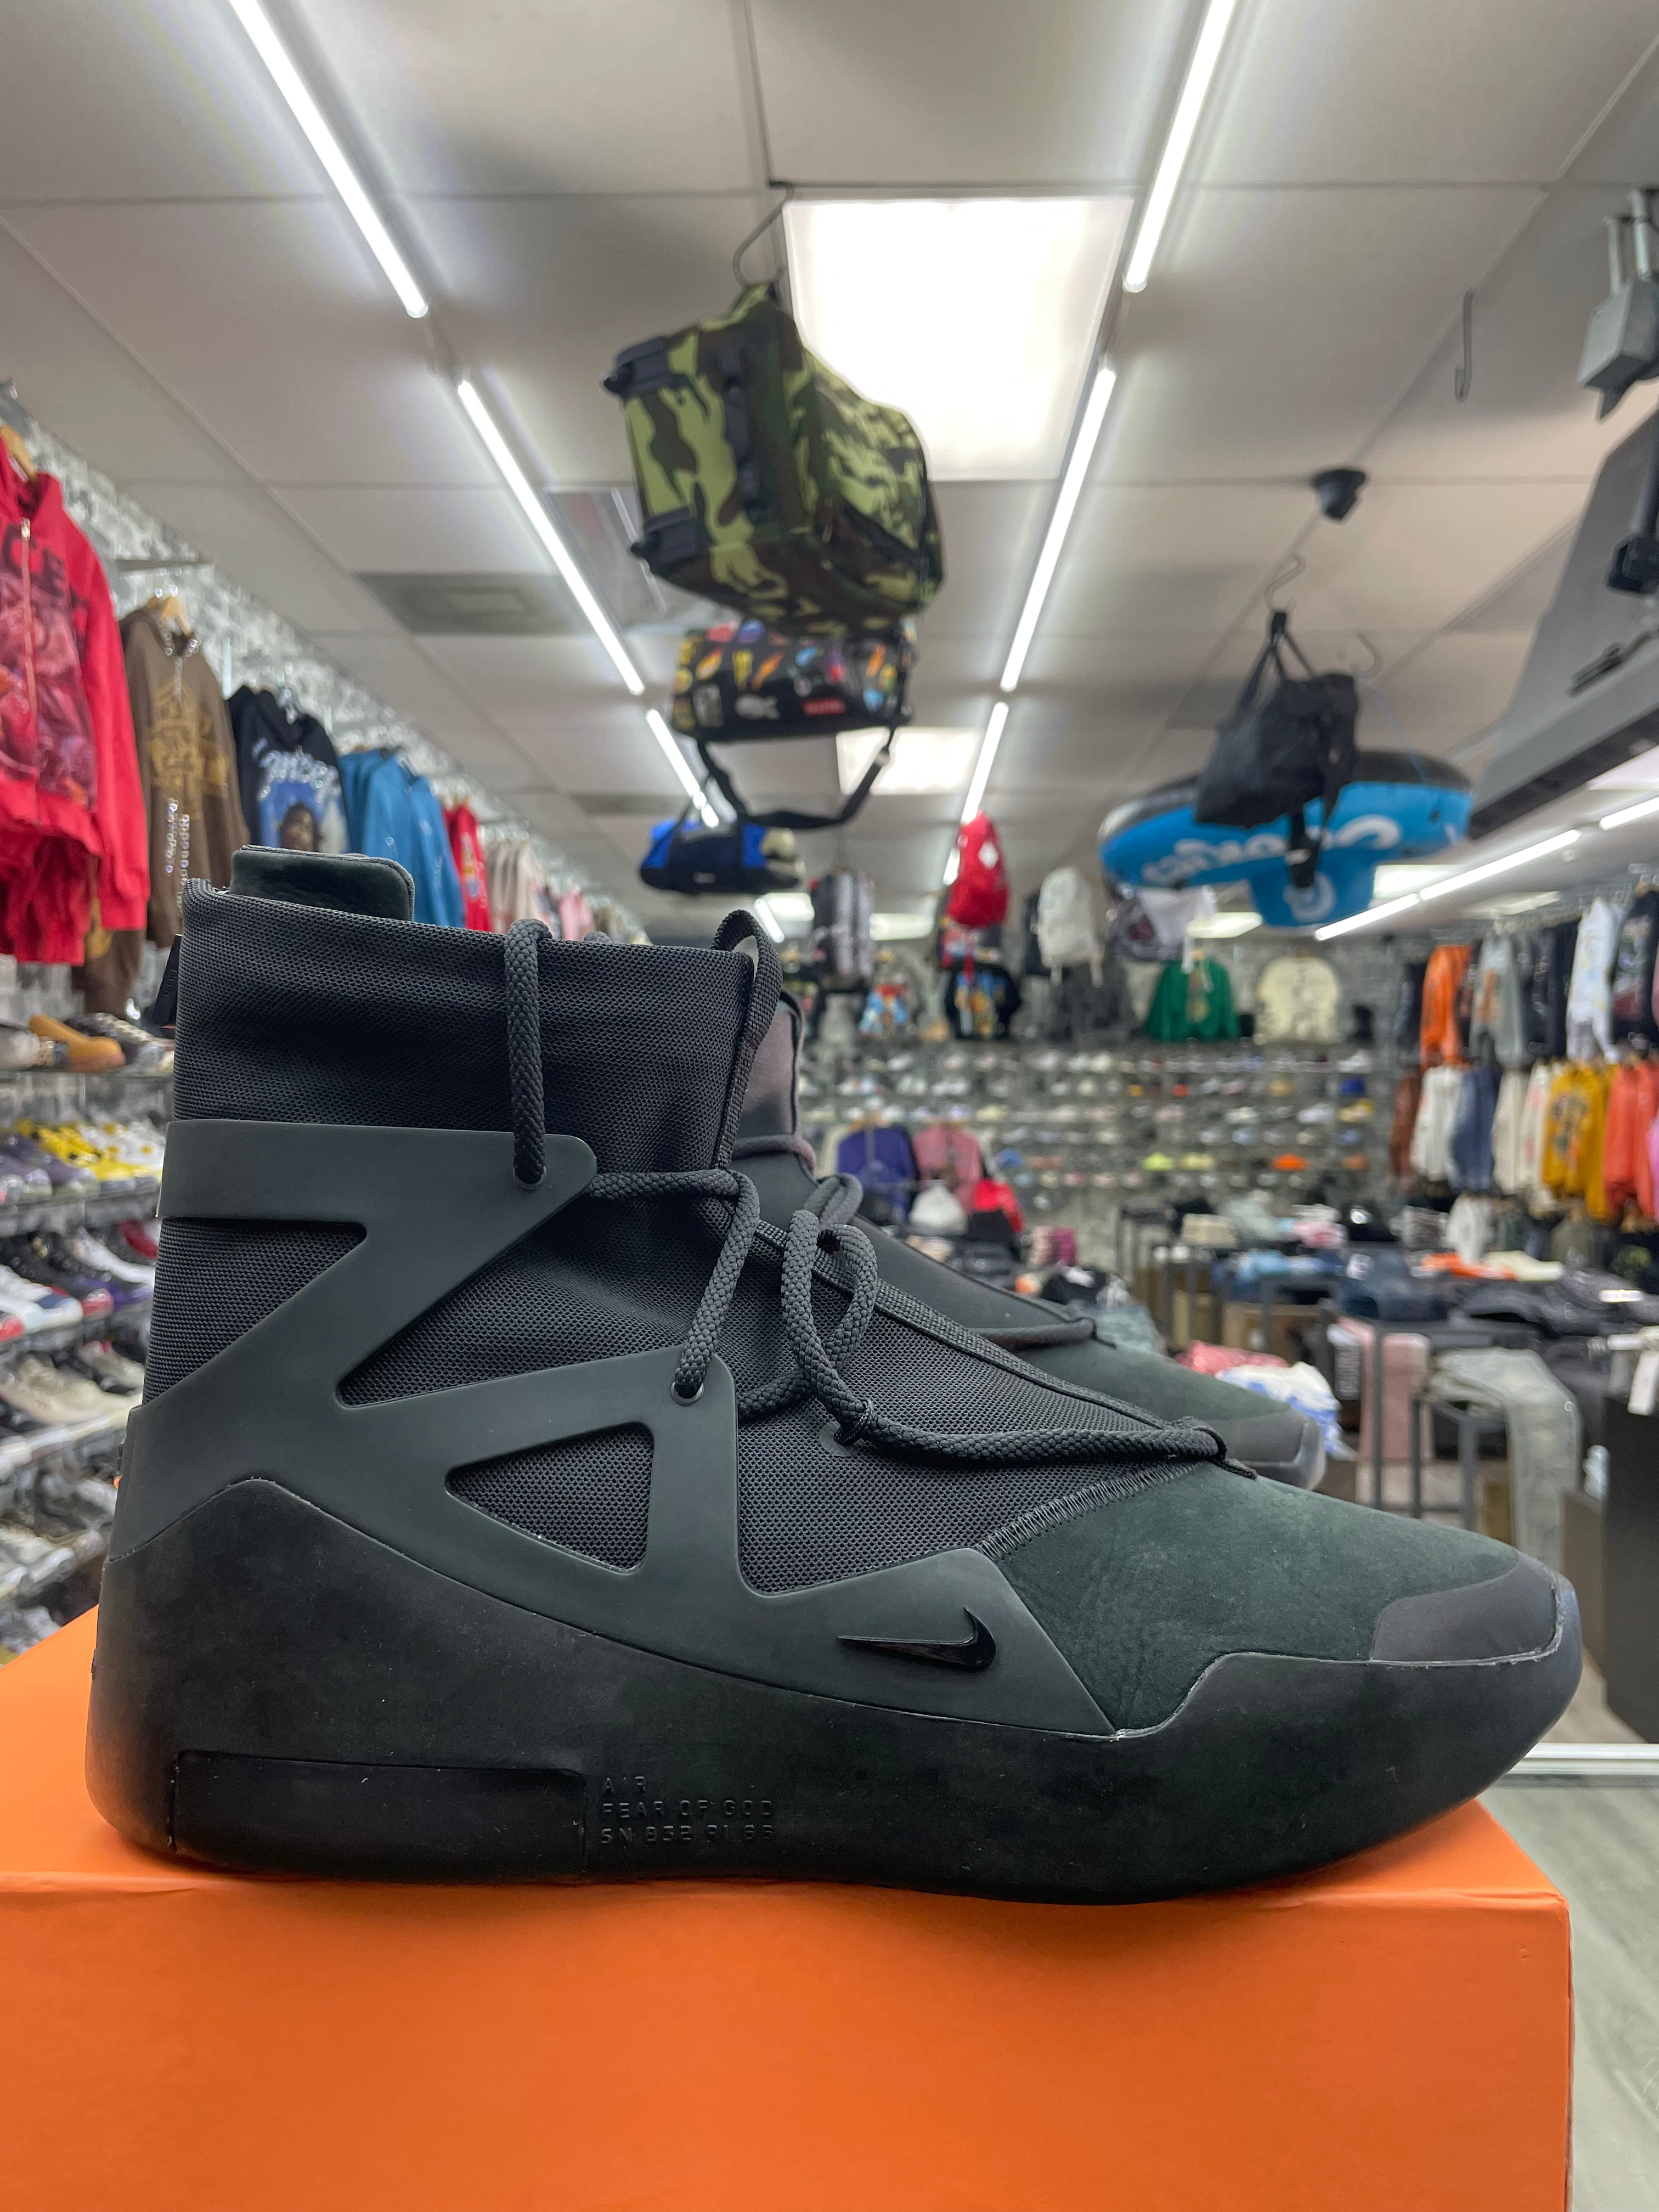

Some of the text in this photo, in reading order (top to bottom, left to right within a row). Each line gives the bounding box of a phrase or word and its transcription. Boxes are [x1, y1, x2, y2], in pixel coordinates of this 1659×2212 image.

[602, 1799, 772, 1818] FEAR OF GOD
[601, 1827, 633, 1844] SN
